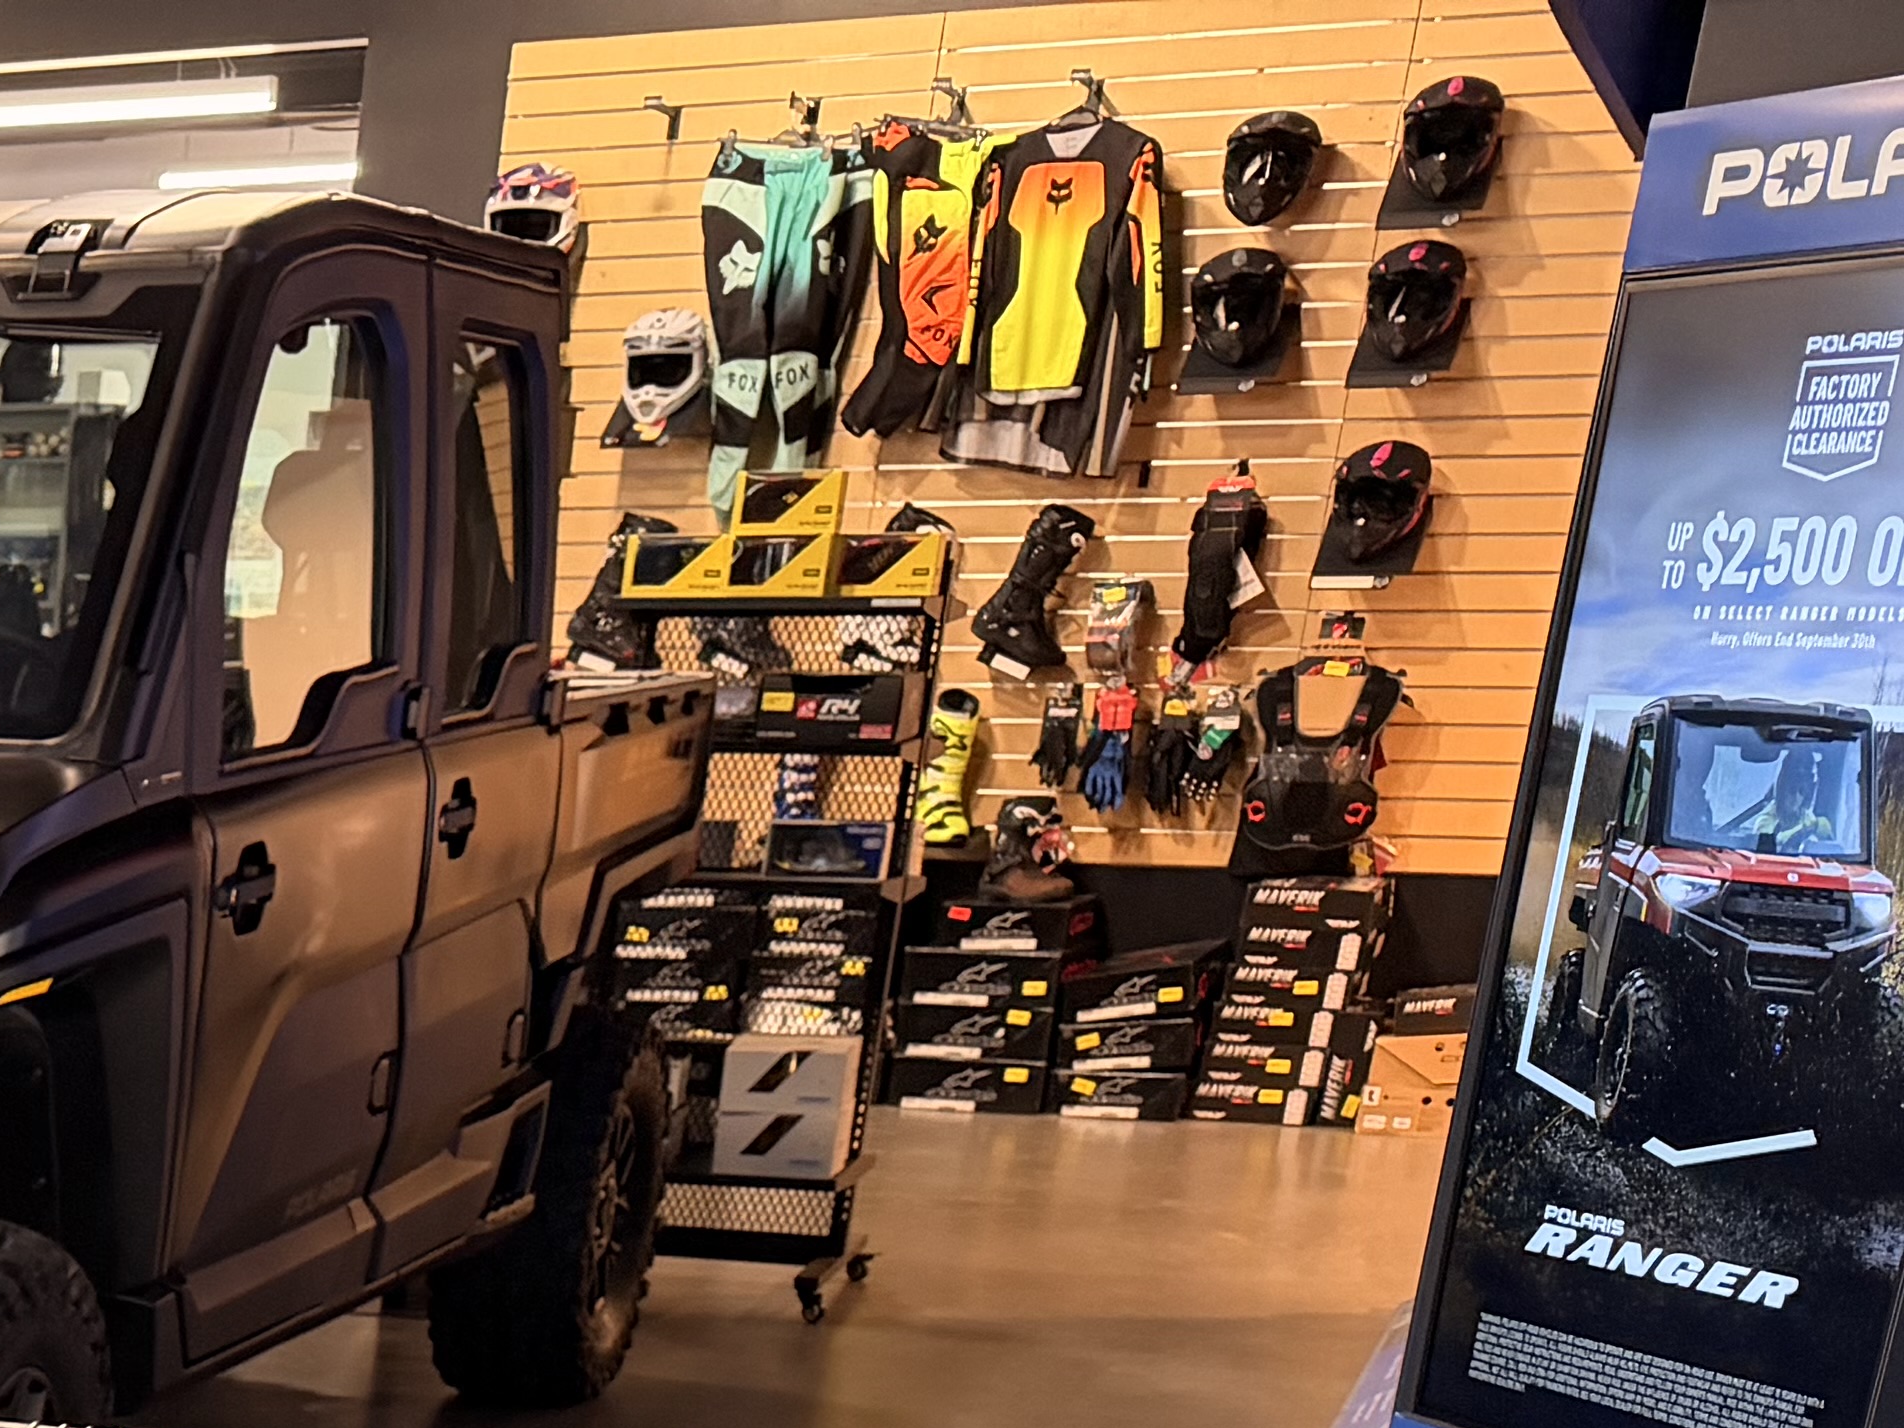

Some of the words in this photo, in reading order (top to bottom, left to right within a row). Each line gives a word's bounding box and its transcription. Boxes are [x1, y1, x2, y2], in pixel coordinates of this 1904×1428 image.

[1805, 329, 1904, 354] POLARIS
[728, 371, 760, 393] FOX
[774, 363, 811, 389] FOX
[1807, 372, 1883, 401] FACTORY
[1789, 401, 1890, 431] AUTHORIZED
[1791, 430, 1877, 456] CLEARANCE
[1668, 522, 1694, 552] UP
[1697, 511, 1858, 594] $2,500
[1662, 560, 1685, 589] TO
[1693, 605, 1711, 621] ON
[1719, 605, 1774, 621] SELECT
[1780, 606, 1839, 622] RANGER
[1846, 607, 1904, 622] MODELS
[1742, 632, 1773, 647] Offers
[1774, 631, 1793, 647] End
[1795, 632, 1849, 651] September
[1851, 632, 1875, 648] 30th
[1252, 888, 1326, 906] MAVERIK
[1246, 926, 1312, 943] MAVERIK
[1403, 998, 1457, 1014] MAVERIK
[1543, 1203, 1625, 1237] POLARIS
[1524, 1223, 1800, 1309] RANGER
